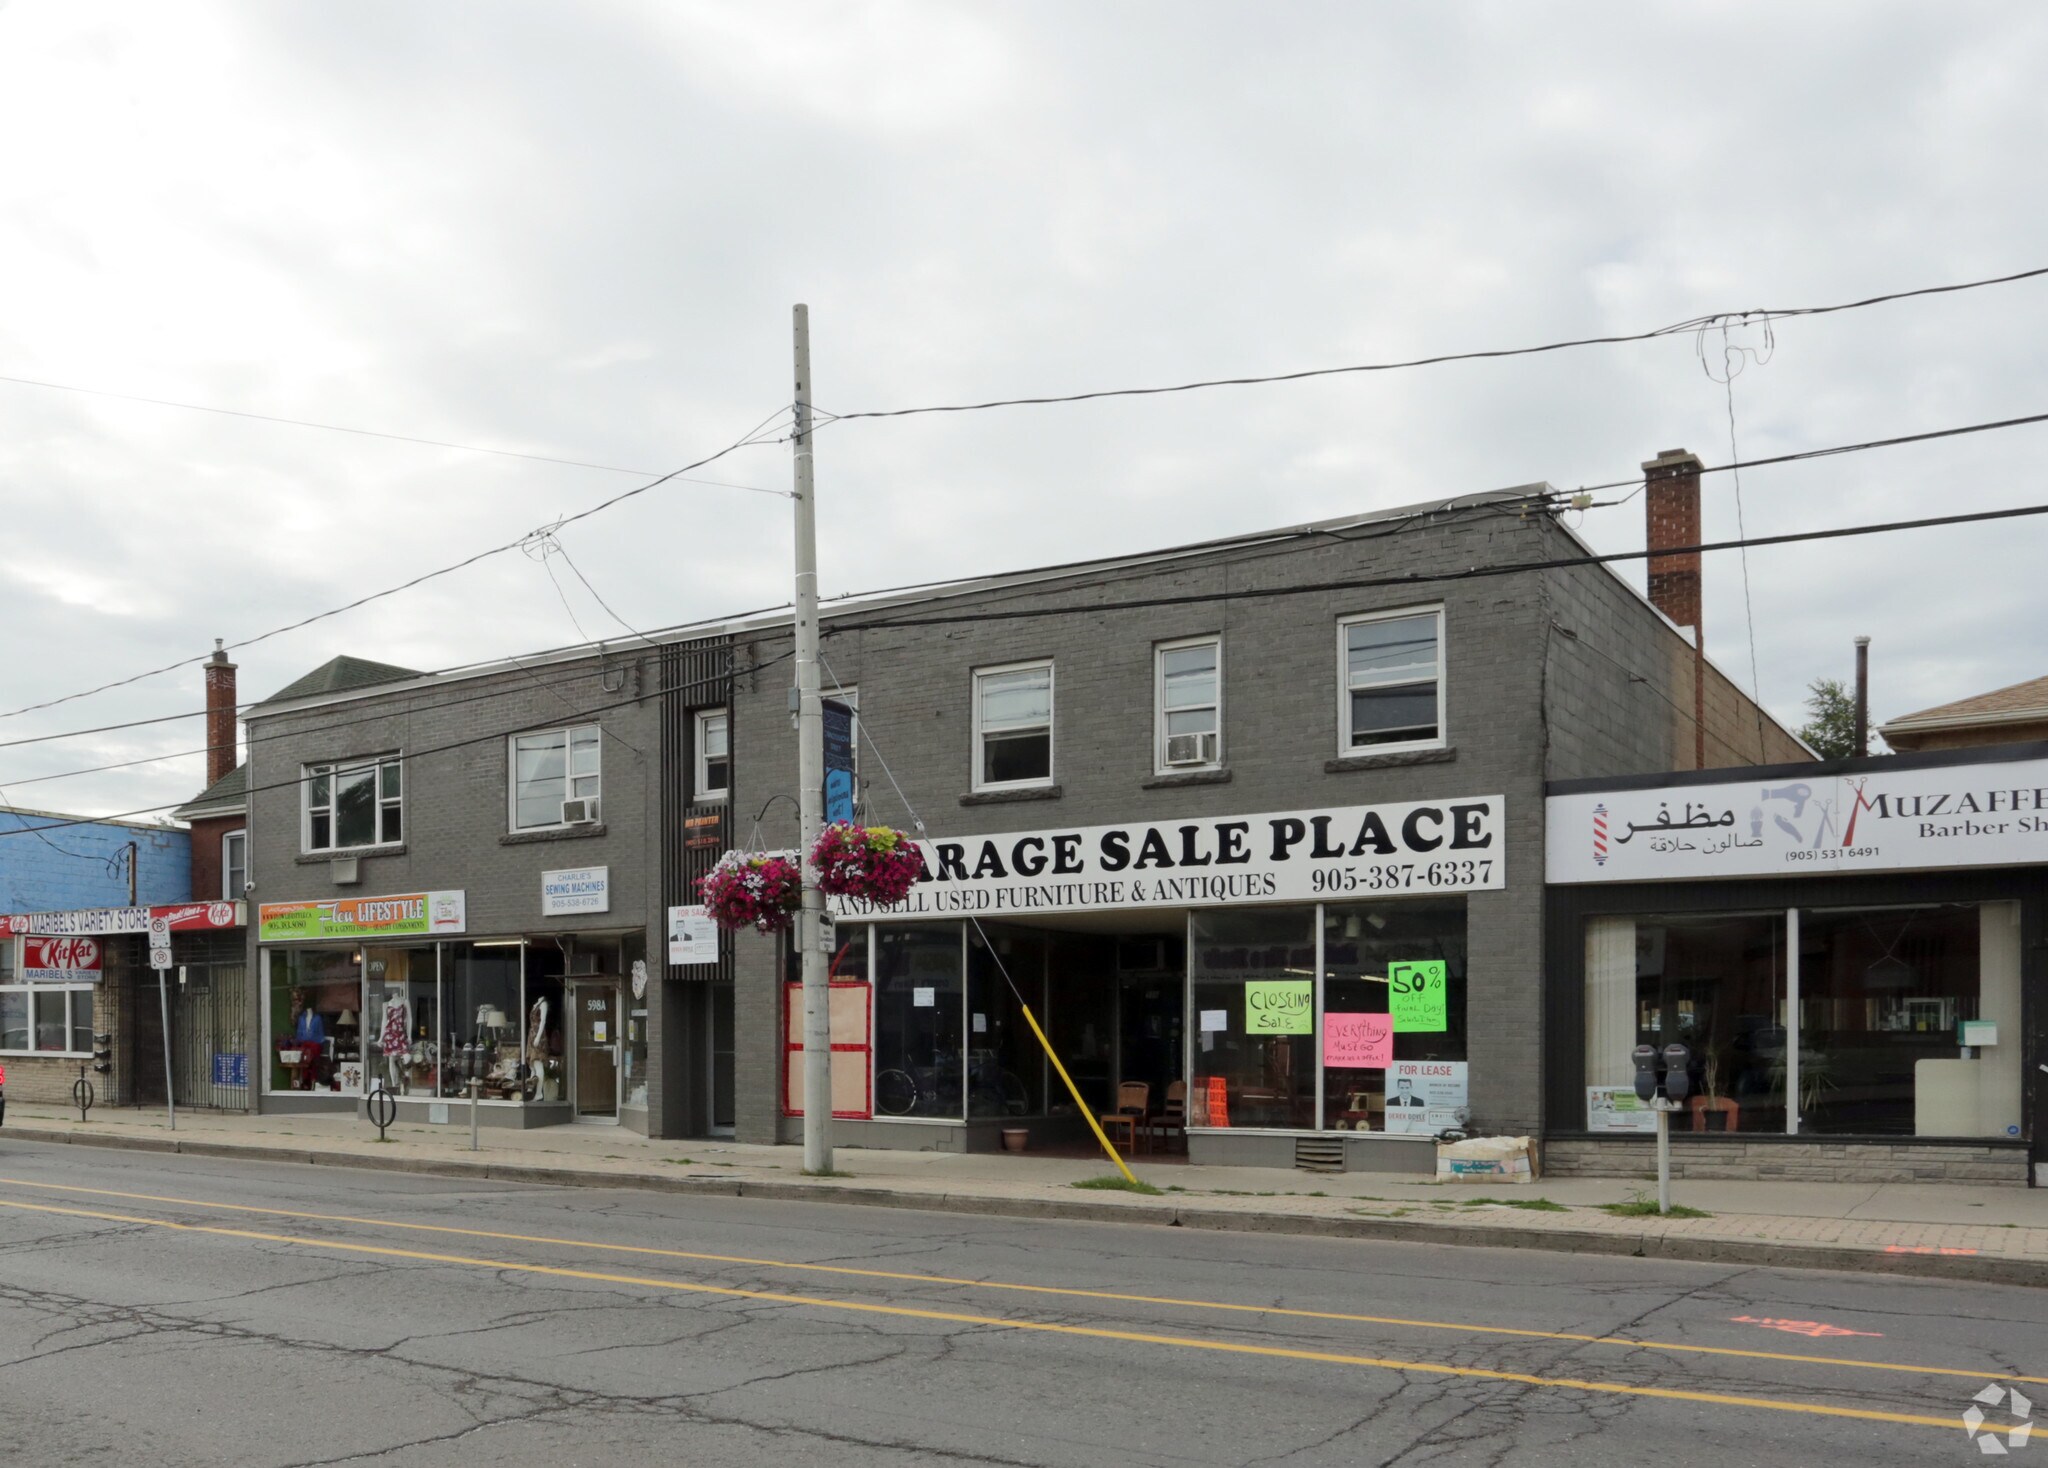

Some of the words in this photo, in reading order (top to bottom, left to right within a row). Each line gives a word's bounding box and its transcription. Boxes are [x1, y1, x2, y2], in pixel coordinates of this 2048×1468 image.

[1615, 802, 1735, 843] مظفر
[1919, 820, 2009, 838] Barber
[917, 834, 1085, 882] RAGE
[1100, 821, 1251, 871] SALE
[1268, 803, 1492, 861] PLACE
[1650, 836, 1697, 852] حلاقة
[1703, 833, 1763, 854] صالون
[1785, 851, 1818, 862] (905)
[1821, 849, 1843, 860] 531
[1848, 847, 1879, 858] 6491
[558, 872, 591, 881] CHARLIE'S
[1312, 860, 1492, 892] 905-387-6337
[546, 883, 570, 895] SEWING
[571, 881, 605, 893] MACHINES
[836, 893, 876, 915] AND
[935, 889, 990, 911] USED
[996, 881, 1125, 909] FURNITURE
[1131, 880, 1146, 901] &
[1152, 872, 1276, 900] ANTIQUES
[358, 899, 424, 922] LIFESTYLE
[677, 909, 689, 917] FOR
[31, 913, 76, 933] MARIBEL'S
[78, 911, 114, 931] VARIETY
[118, 908, 147, 929] STORE
[47, 938, 92, 969] KitKat
[26, 969, 73, 980] MARIBEL'S
[587, 999, 606, 1010] 598A
[1399, 1065, 1417, 1075] FOR
[1421, 1065, 1452, 1076] LEASE
